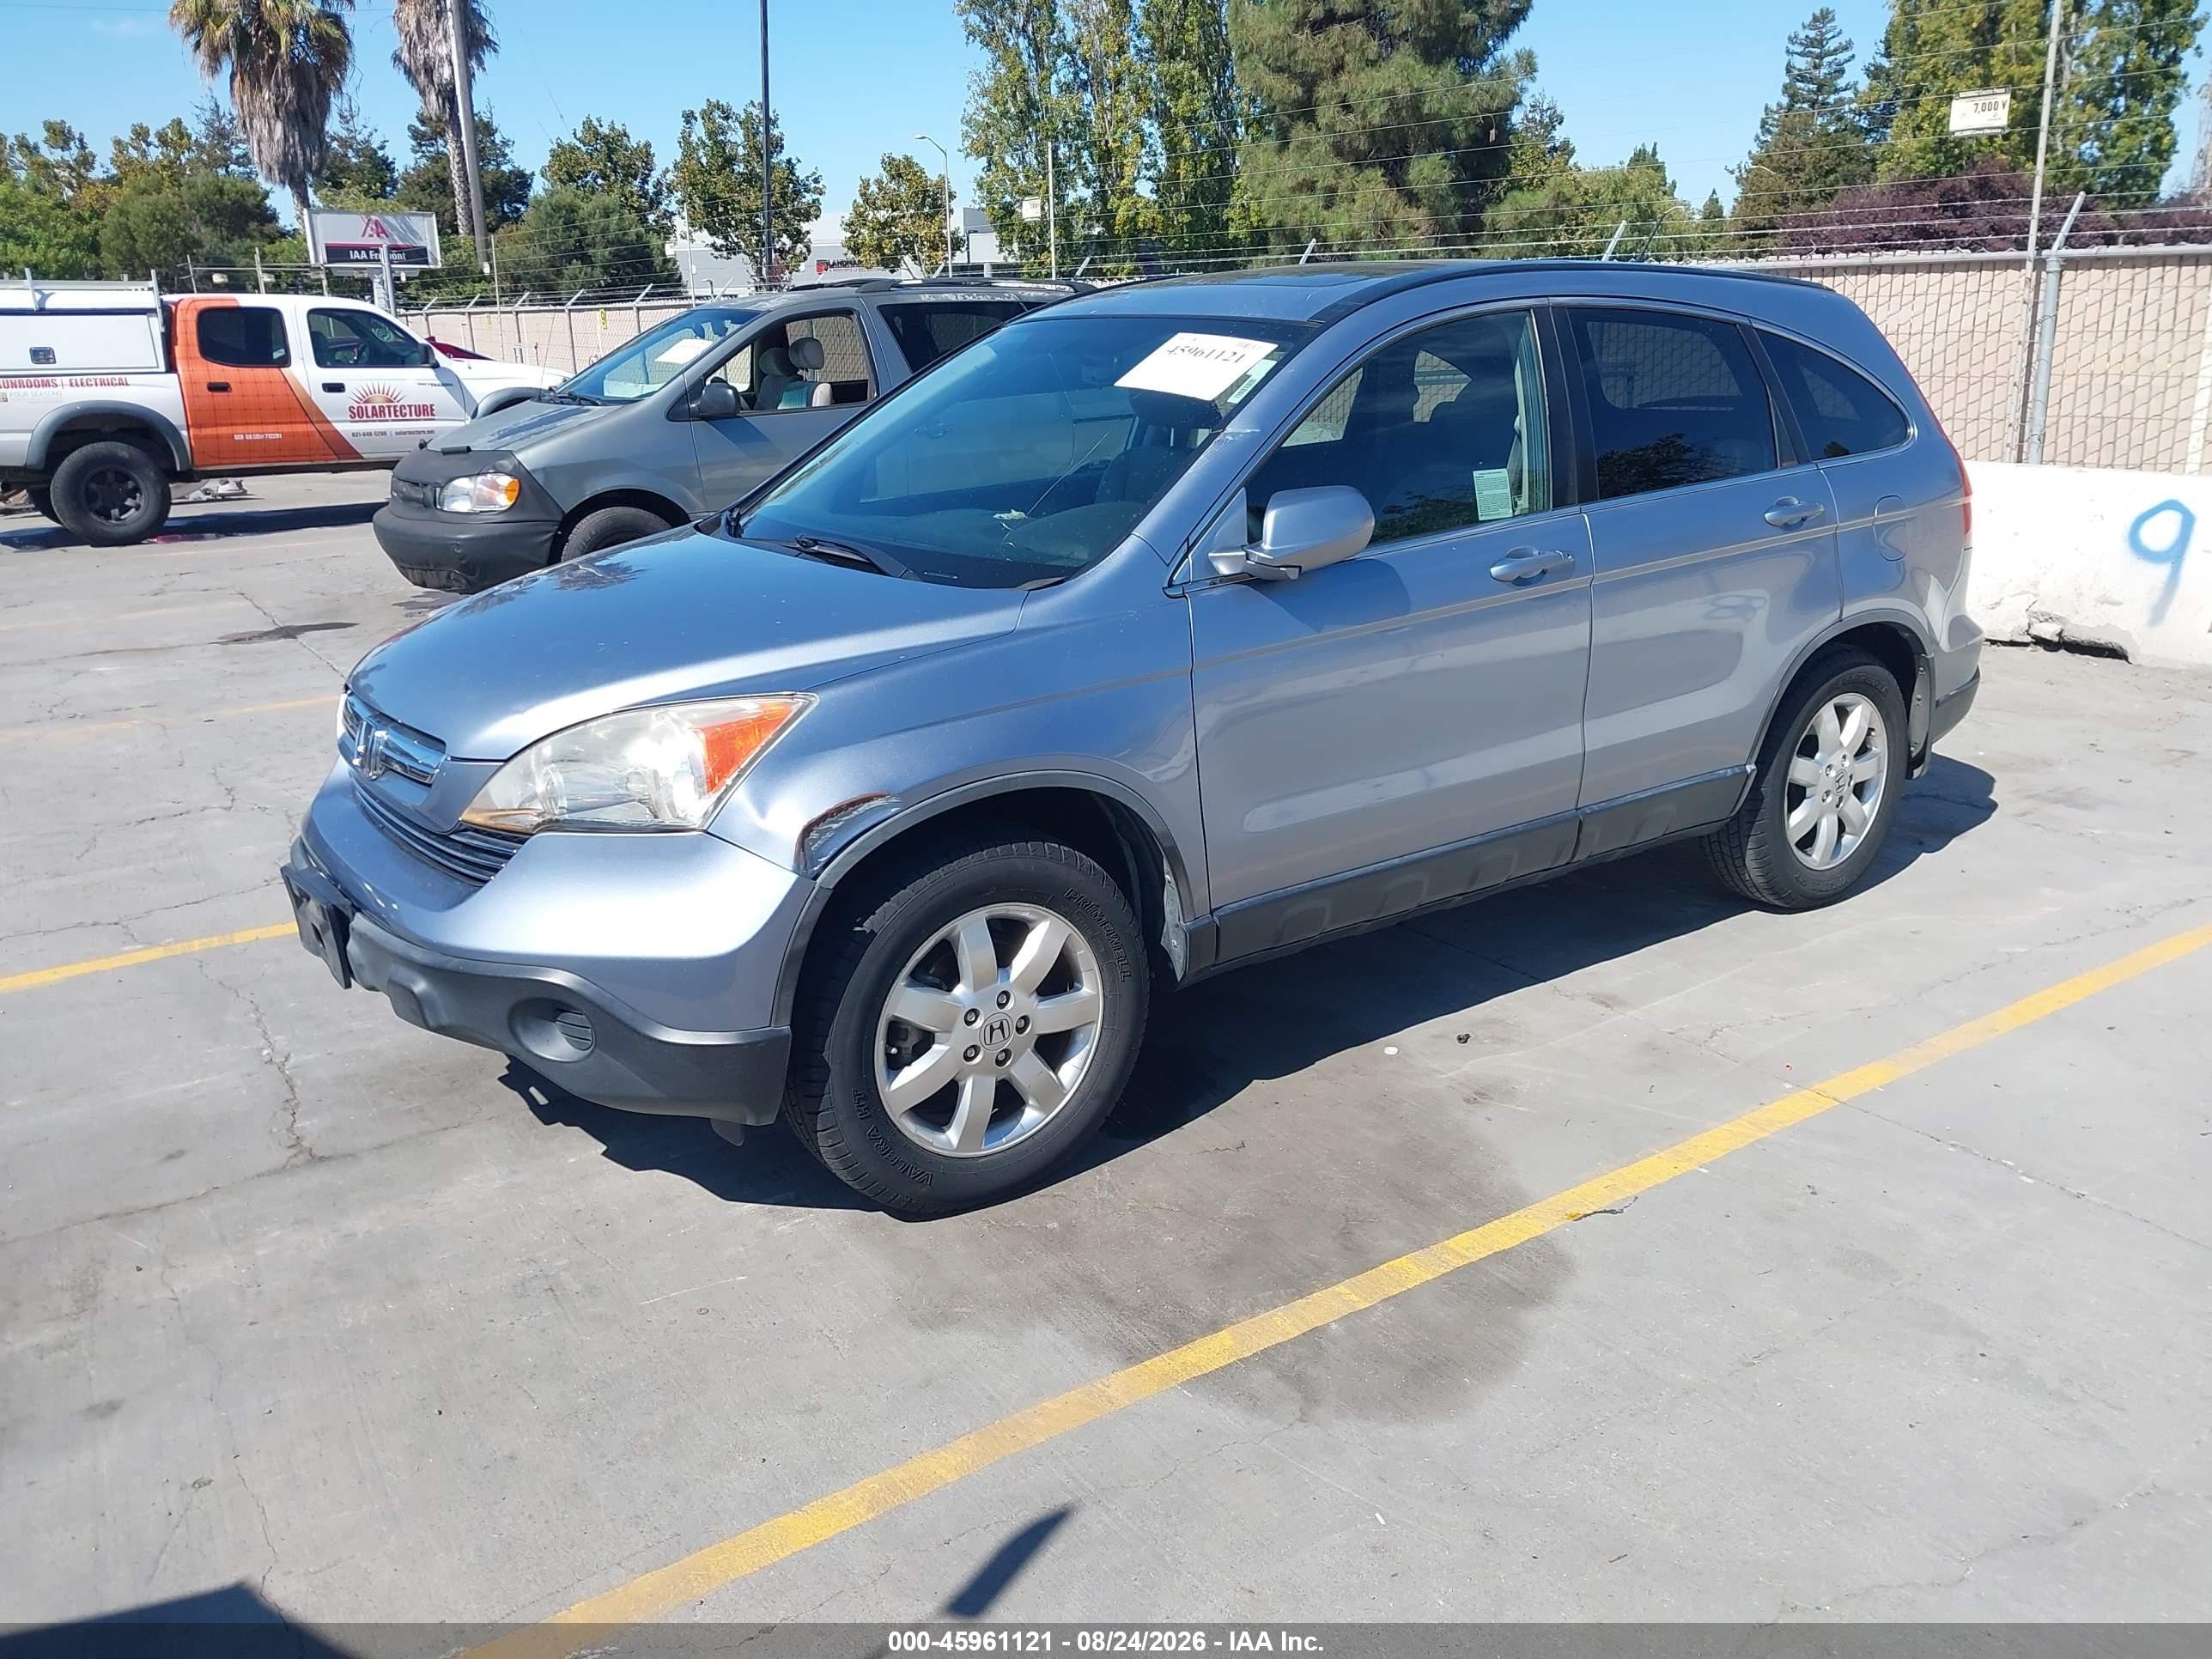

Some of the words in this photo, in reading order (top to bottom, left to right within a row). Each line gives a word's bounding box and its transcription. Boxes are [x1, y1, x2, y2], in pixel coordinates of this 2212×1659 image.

[1973, 100, 1999, 114] 7,000
[349, 250, 368, 260] IAA
[1166, 345, 1247, 363] 45961121
[68, 376, 131, 388] ELECTRICAL
[348, 404, 436, 420] SOLARTECTURE
[2128, 499, 2196, 628] 9
[1064, 886, 1132, 983] PRIMEWELL
